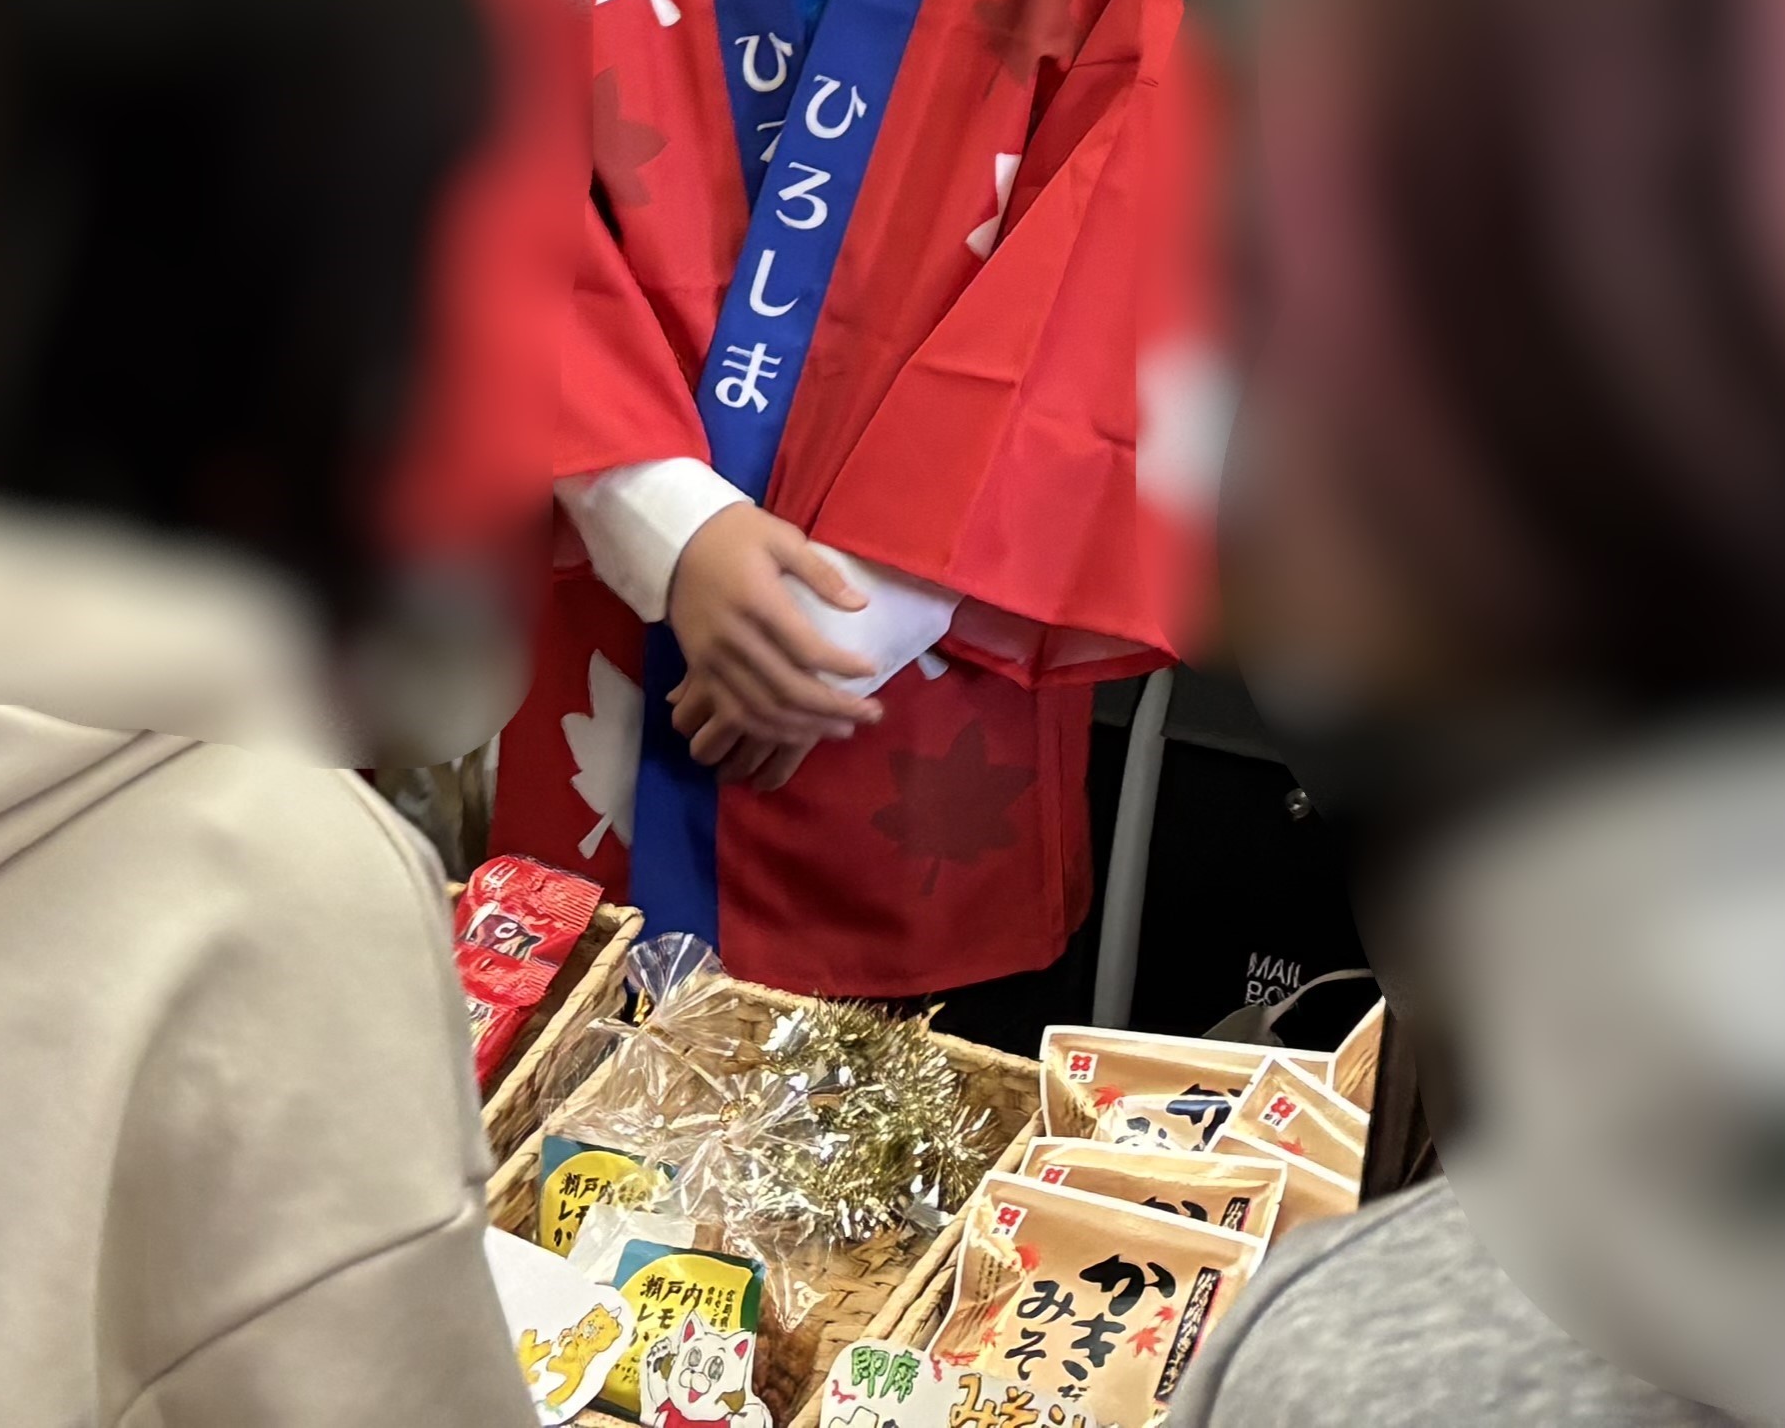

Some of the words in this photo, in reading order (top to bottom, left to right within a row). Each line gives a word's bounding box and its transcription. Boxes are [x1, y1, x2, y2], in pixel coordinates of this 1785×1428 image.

[715, 74, 868, 415] ひろしま
[1244, 980, 1293, 1007] BO
[639, 1274, 704, 1310] 瀬戸内
[1004, 1279, 1077, 1381] みそ
[851, 1345, 920, 1404] 即席
